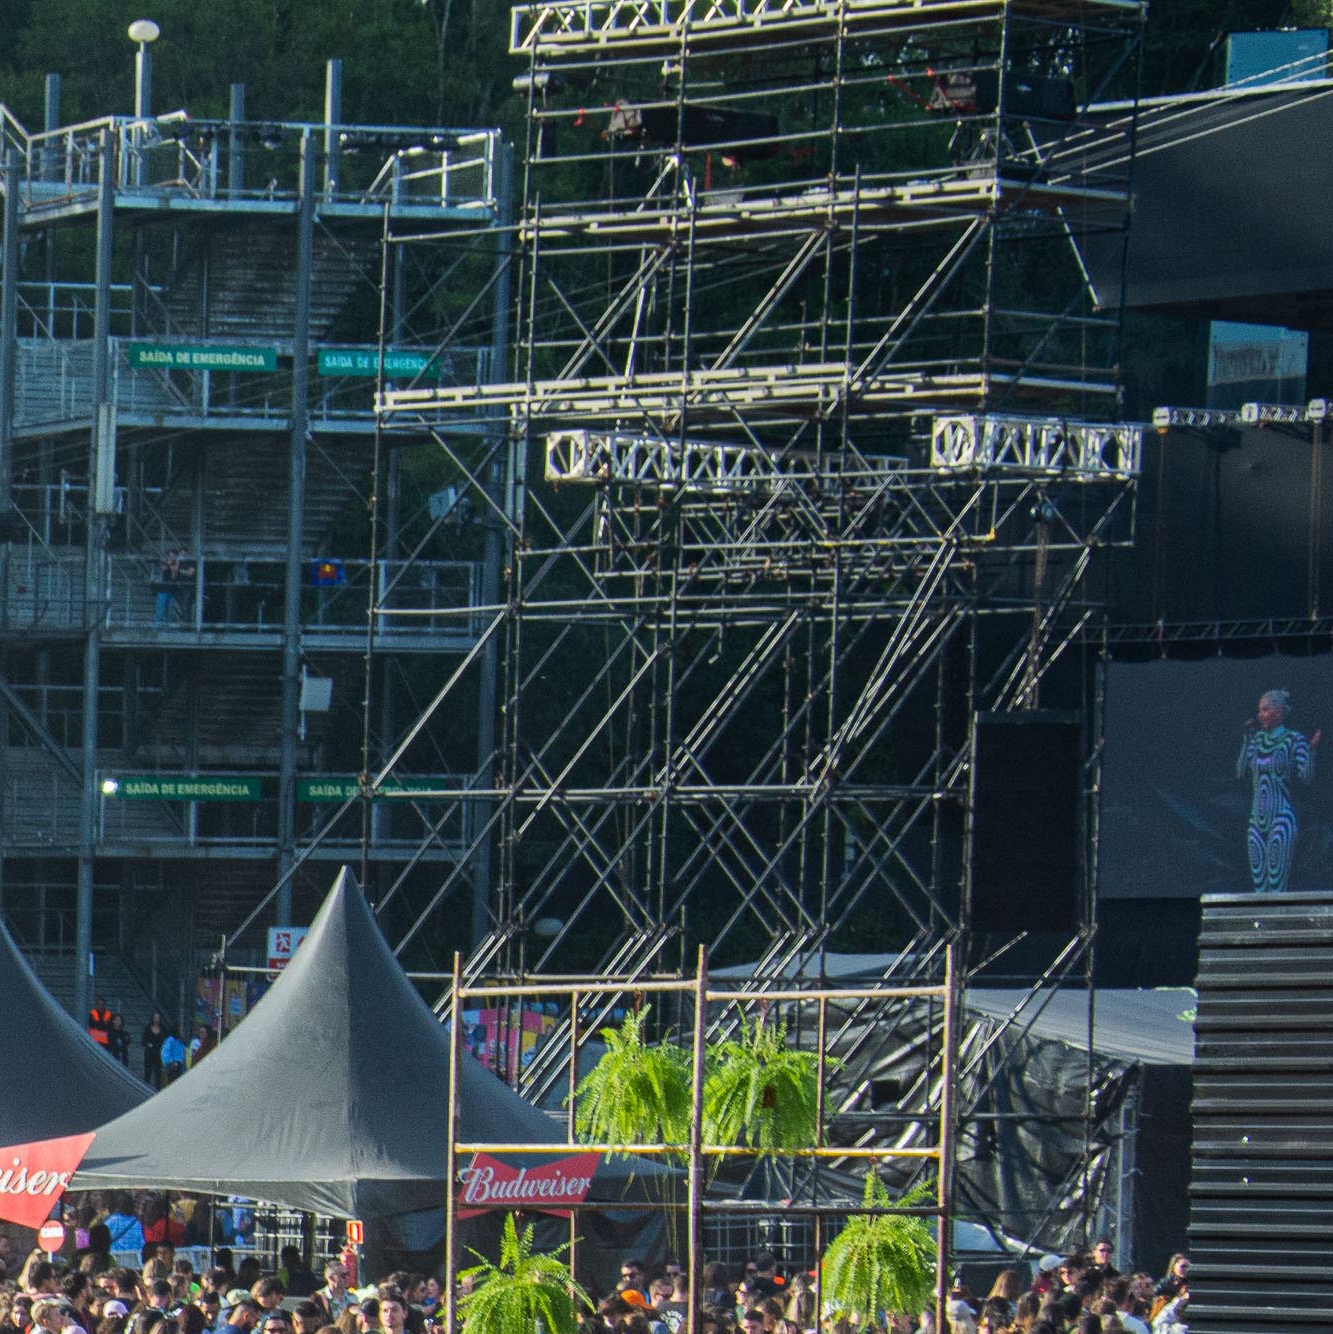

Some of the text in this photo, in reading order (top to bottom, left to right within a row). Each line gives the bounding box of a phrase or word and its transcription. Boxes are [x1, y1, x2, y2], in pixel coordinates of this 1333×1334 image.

[139, 349, 265, 366] SAÍDA DE EMERGÊNCIA
[125, 781, 250, 796] SAÍDA DE EMERGÊNCIA
[309, 785, 341, 797] SAÍDA
[457, 1166, 591, 1204] Budweiser
